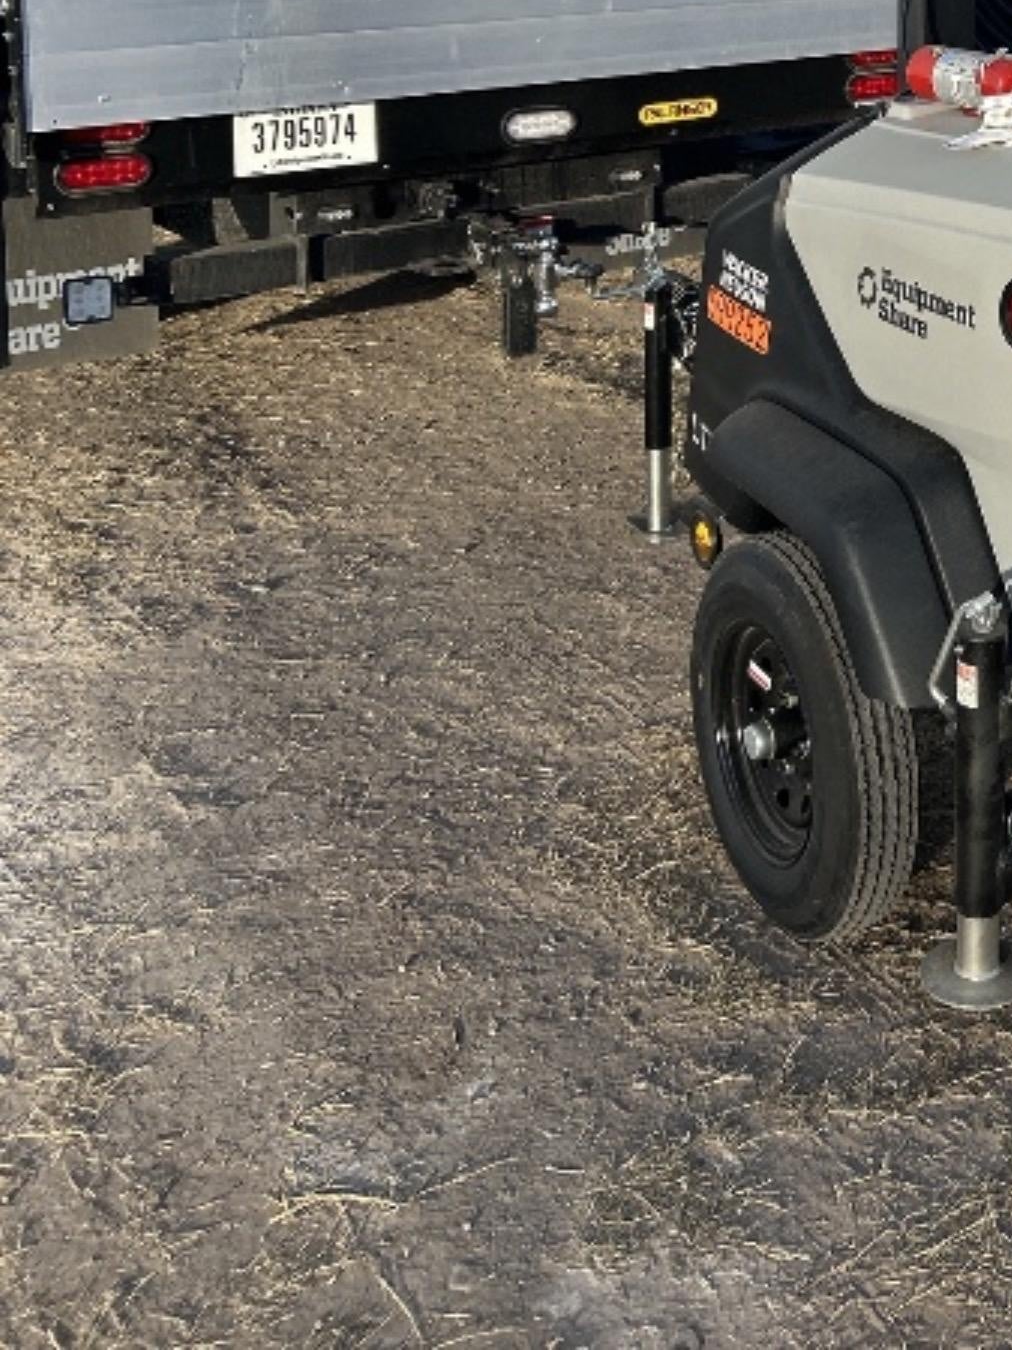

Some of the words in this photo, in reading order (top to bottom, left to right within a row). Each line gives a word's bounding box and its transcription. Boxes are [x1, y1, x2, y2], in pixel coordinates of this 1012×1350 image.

[251, 112, 358, 154] 3795974
[878, 296, 928, 340] Share
[881, 267, 976, 330] Equipment
[8, 321, 61, 354] are
